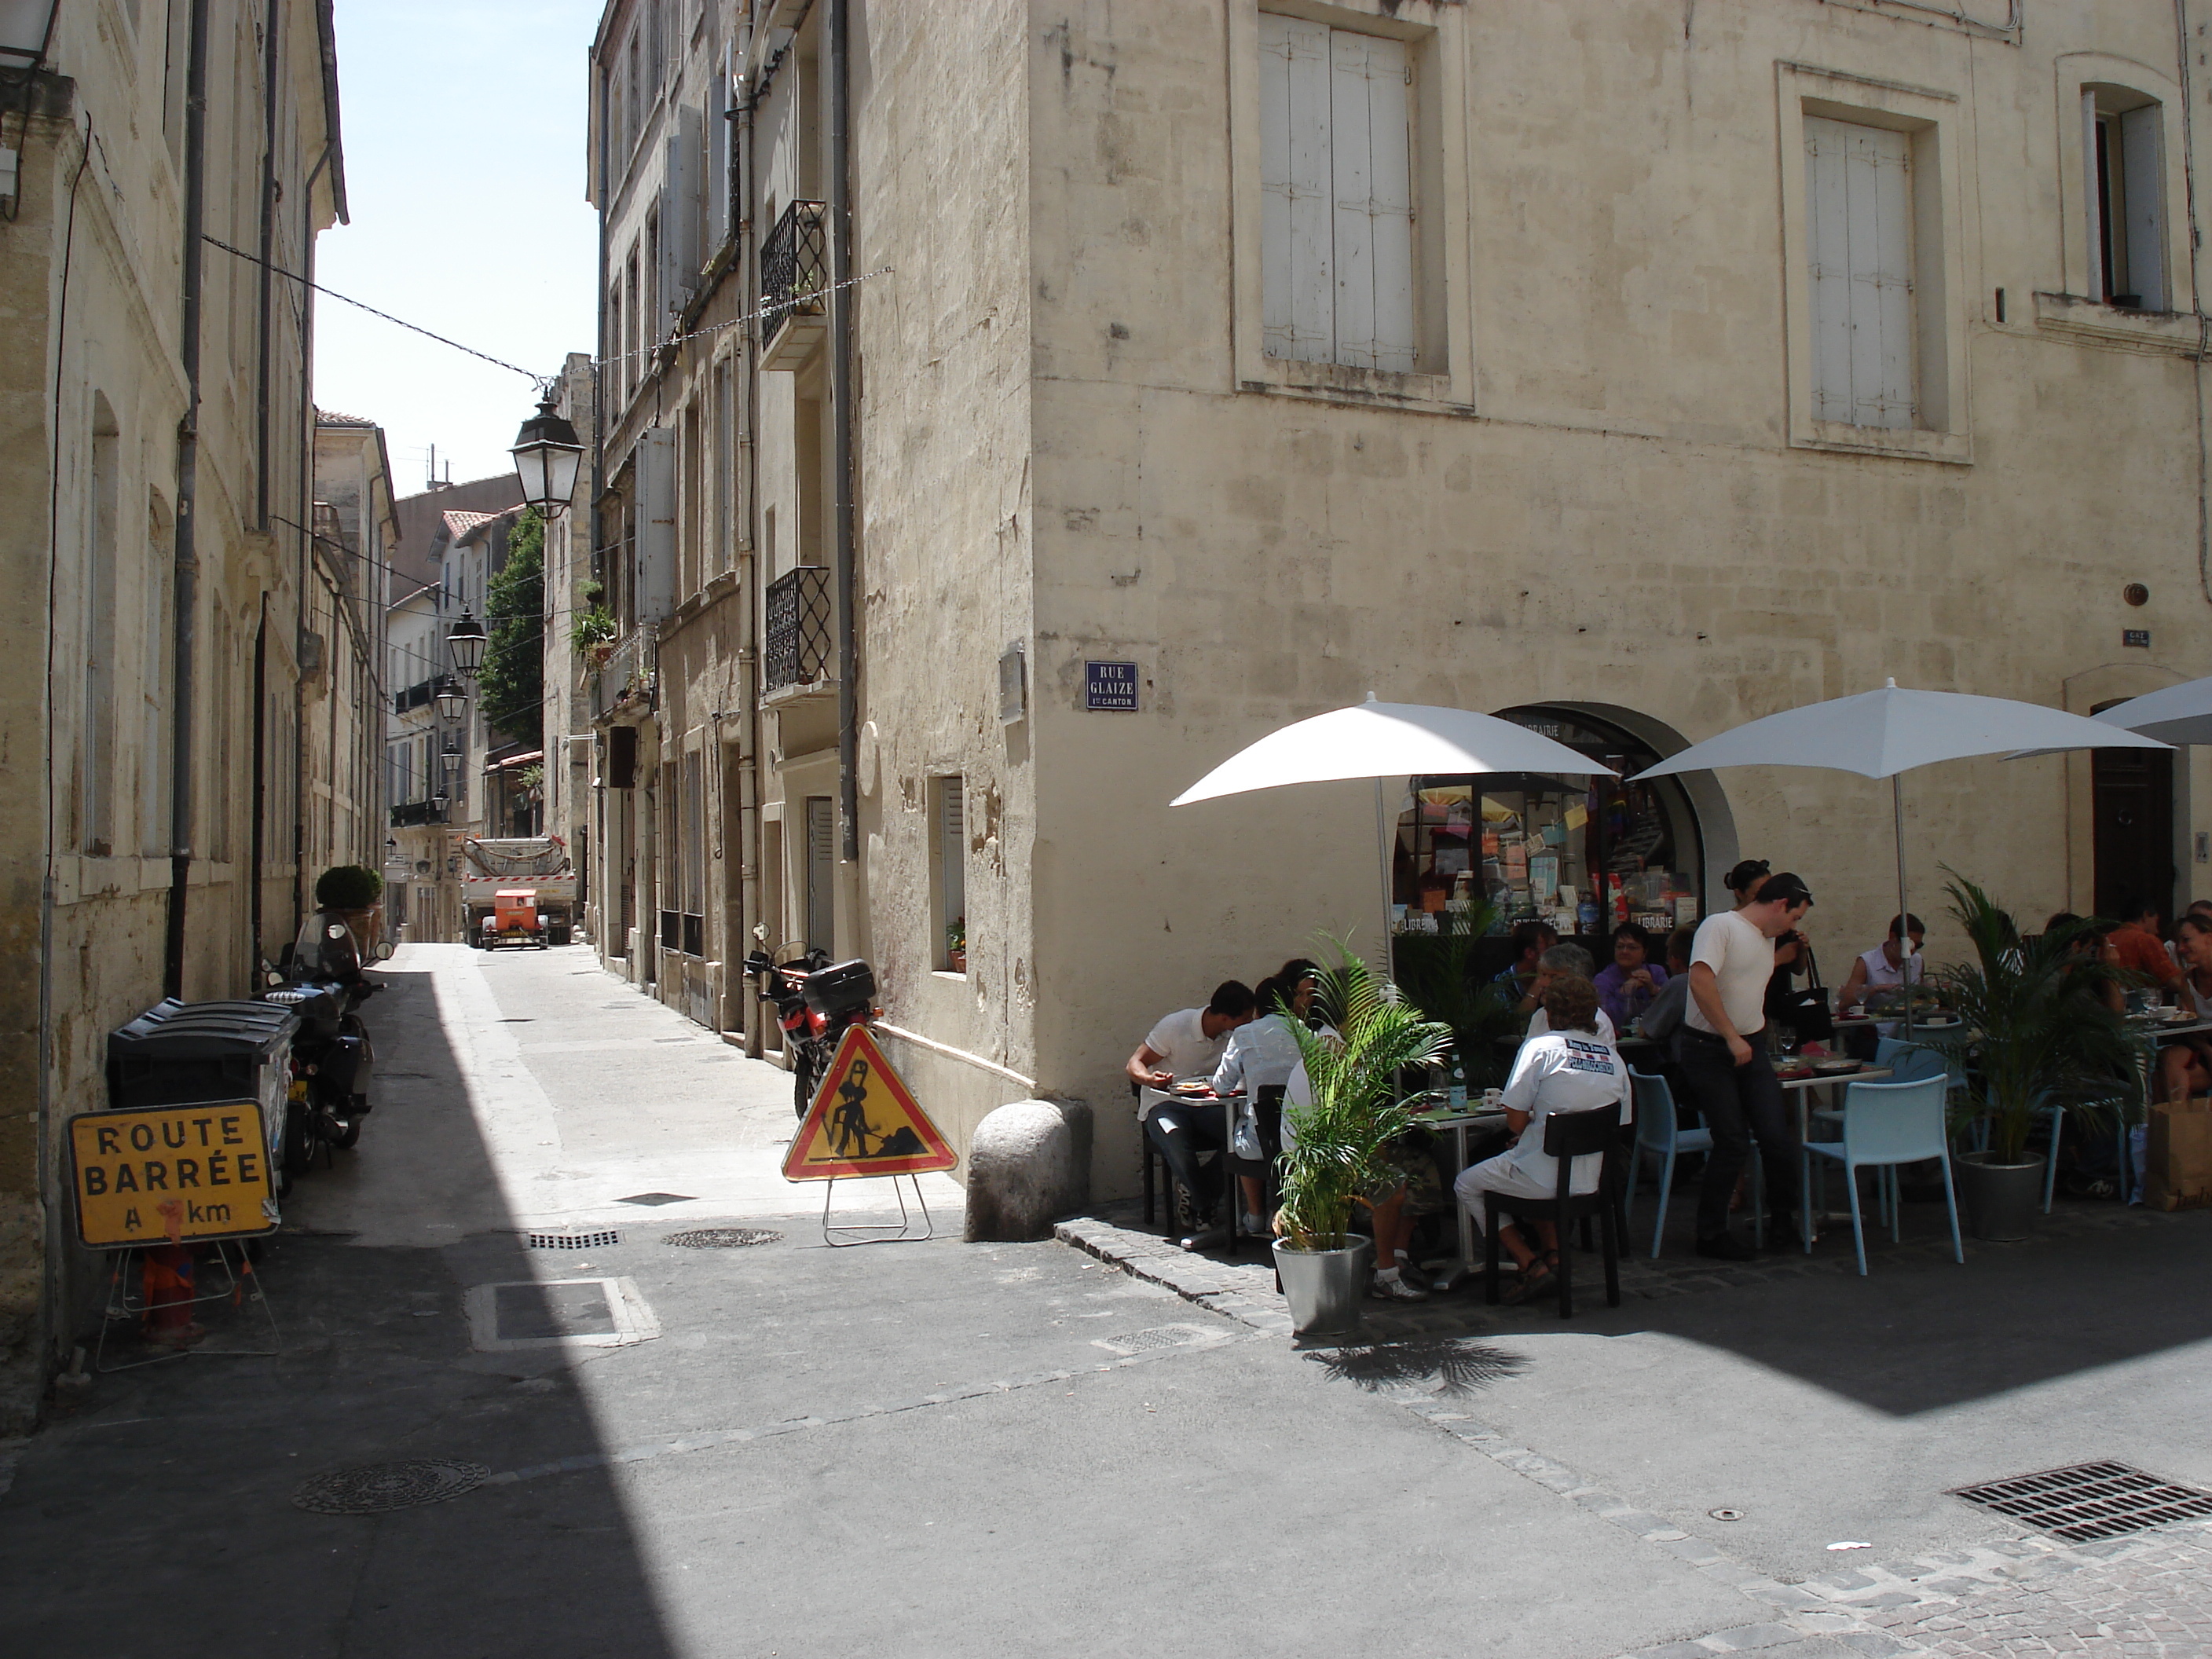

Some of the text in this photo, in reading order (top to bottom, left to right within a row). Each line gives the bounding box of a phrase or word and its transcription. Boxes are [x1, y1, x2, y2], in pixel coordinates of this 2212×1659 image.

[1100, 666, 1124, 679] RUE
[1090, 682, 1133, 694] GLAIZE
[97, 1116, 244, 1155] ROUTE
[85, 1150, 260, 1196] BARRÉE
[124, 1199, 231, 1229] A km
